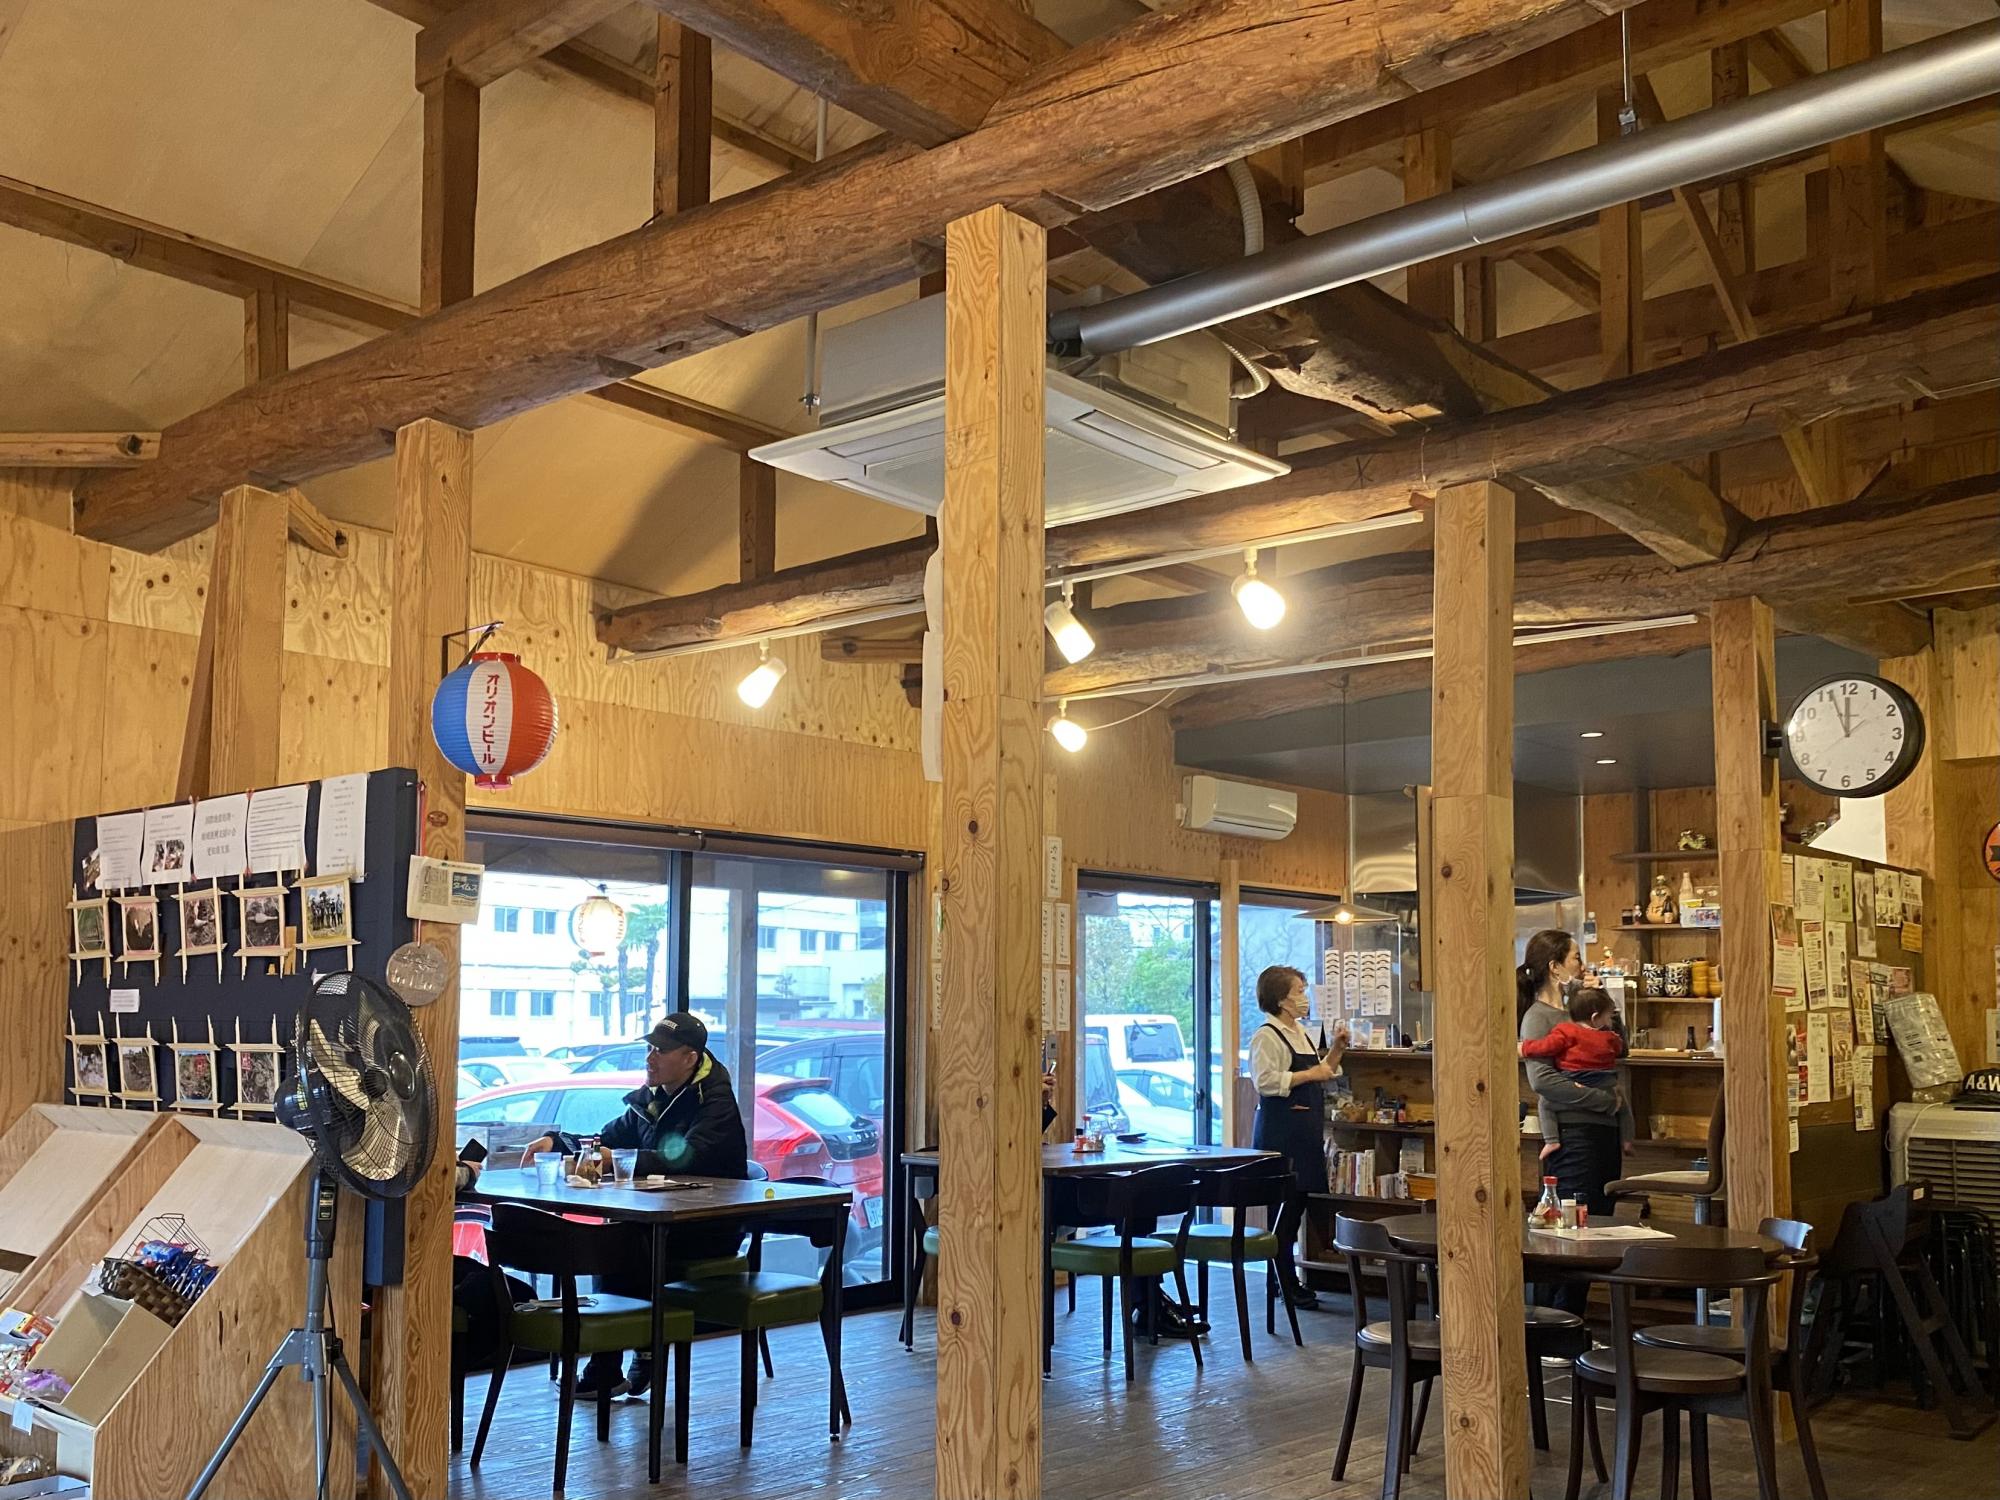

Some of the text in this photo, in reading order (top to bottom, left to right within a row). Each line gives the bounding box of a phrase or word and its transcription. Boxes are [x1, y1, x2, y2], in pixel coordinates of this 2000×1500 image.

[1840, 683, 1858, 695] 12
[1870, 688, 1877, 700] 1
[1817, 690, 1834, 702] 11
[1799, 707, 1817, 720] 10
[1886, 704, 1896, 717] 2
[482, 674, 500, 764] オリオンビール
[1795, 730, 1805, 742] 9
[1892, 727, 1902, 740] 3
[1801, 753, 1810, 765] 8
[1884, 751, 1894, 763] 4
[1817, 769, 1827, 781] 7
[1866, 768, 1876, 781] 5
[1841, 775, 1851, 788] 6
